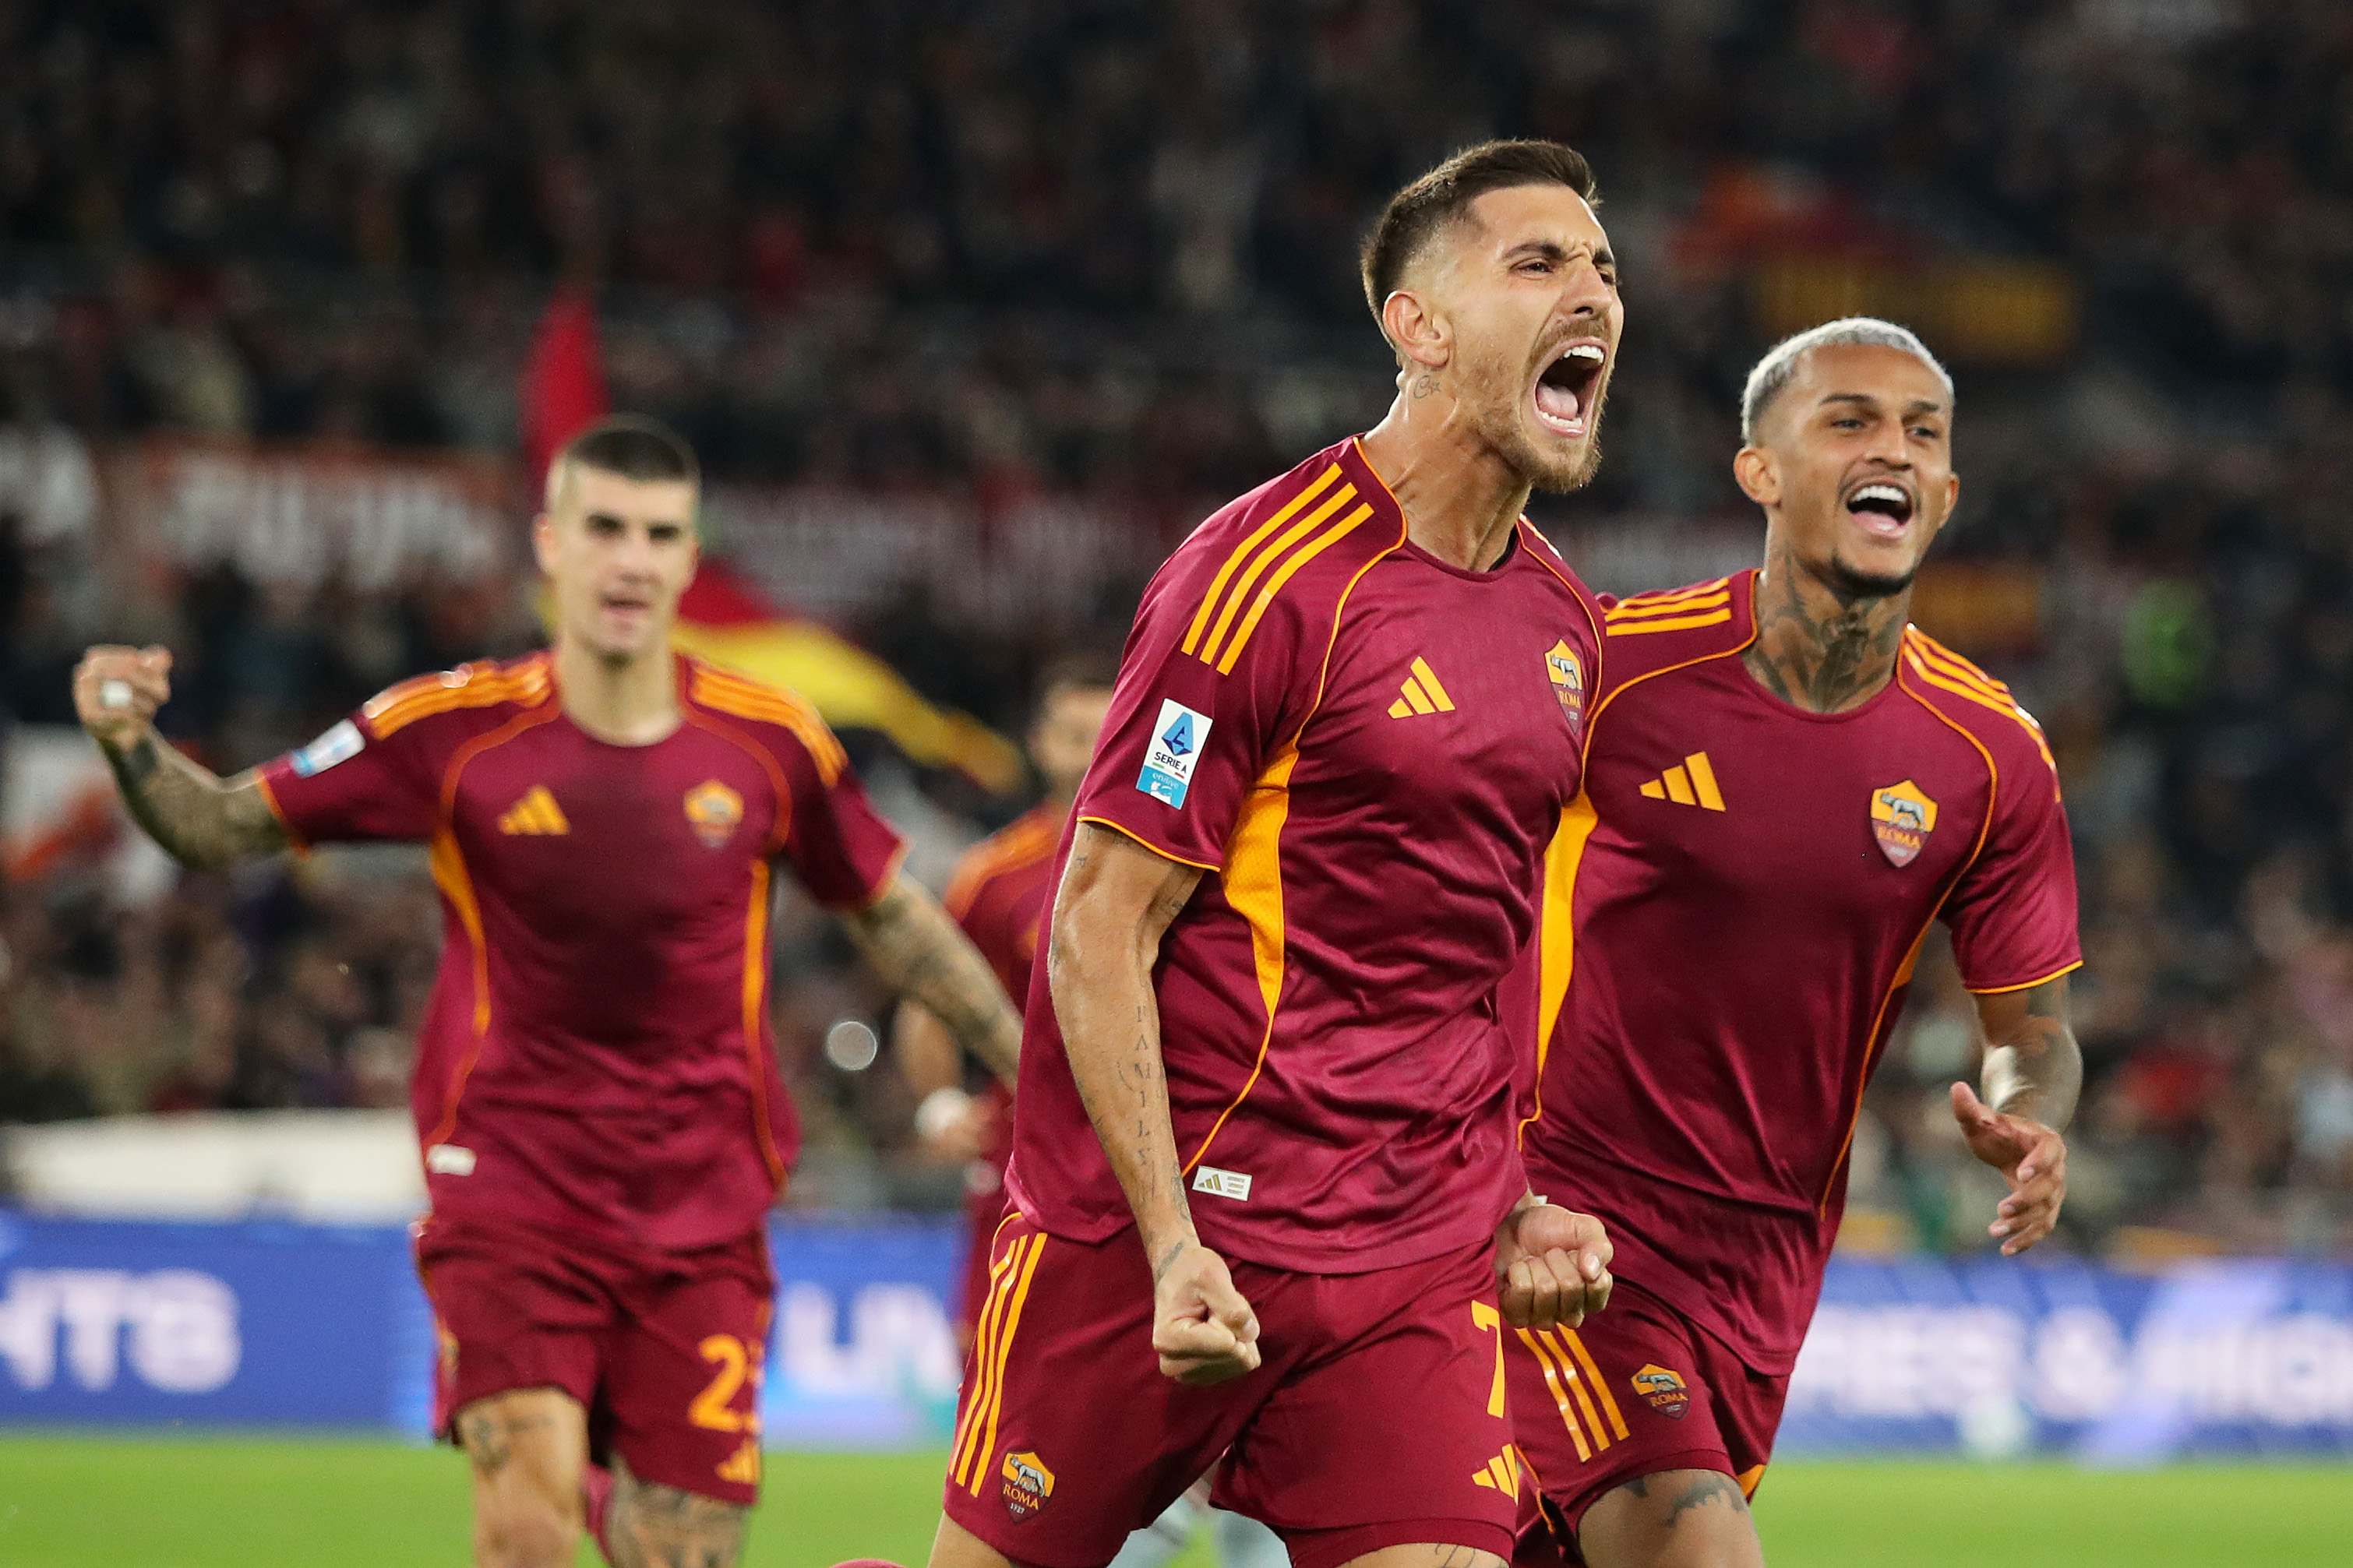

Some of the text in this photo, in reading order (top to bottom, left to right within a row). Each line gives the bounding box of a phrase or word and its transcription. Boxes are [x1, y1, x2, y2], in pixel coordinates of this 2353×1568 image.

[1154, 752, 1187, 773] SERIE A
[1471, 1300, 1505, 1419] 7
[1003, 1483, 1039, 1510] ROMA
